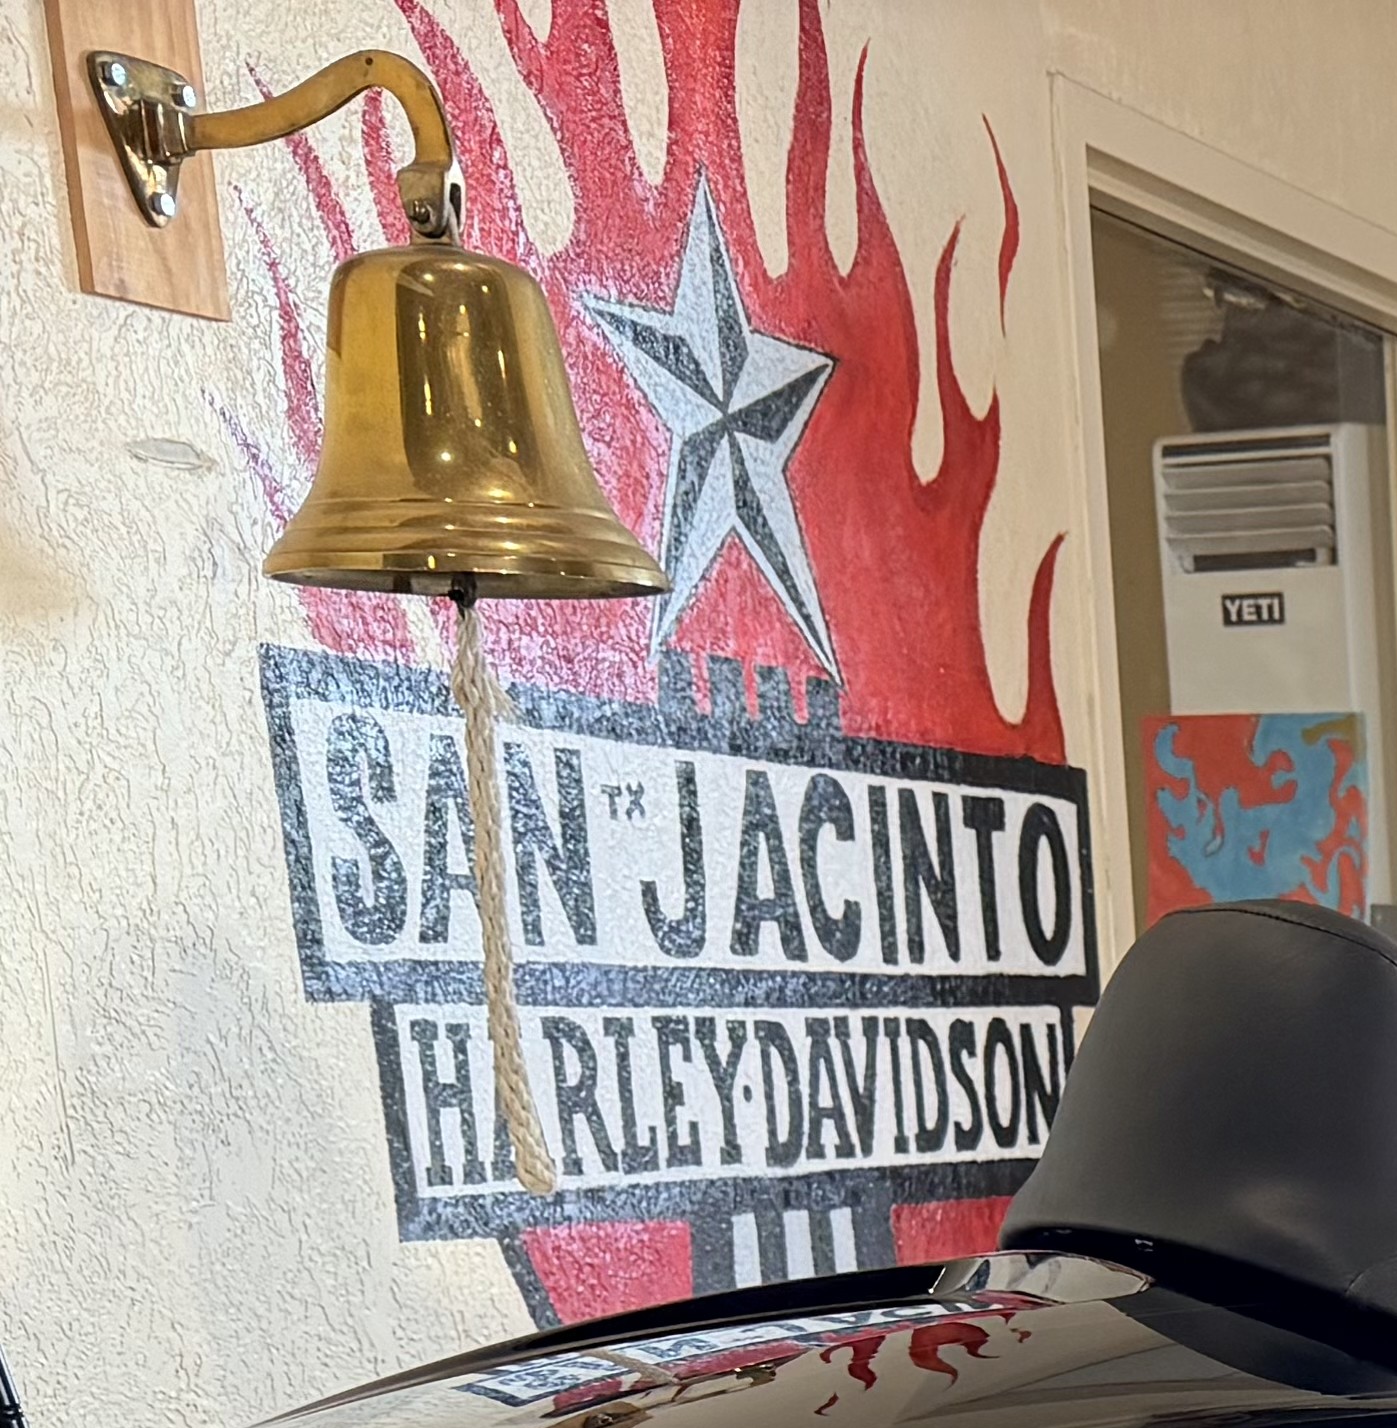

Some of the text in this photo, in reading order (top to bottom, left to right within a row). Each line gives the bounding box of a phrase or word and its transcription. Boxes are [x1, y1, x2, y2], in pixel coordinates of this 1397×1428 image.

[1224, 597, 1281, 623] YETI
[326, 711, 597, 947] SAN
[640, 758, 1071, 967] JACINTO
